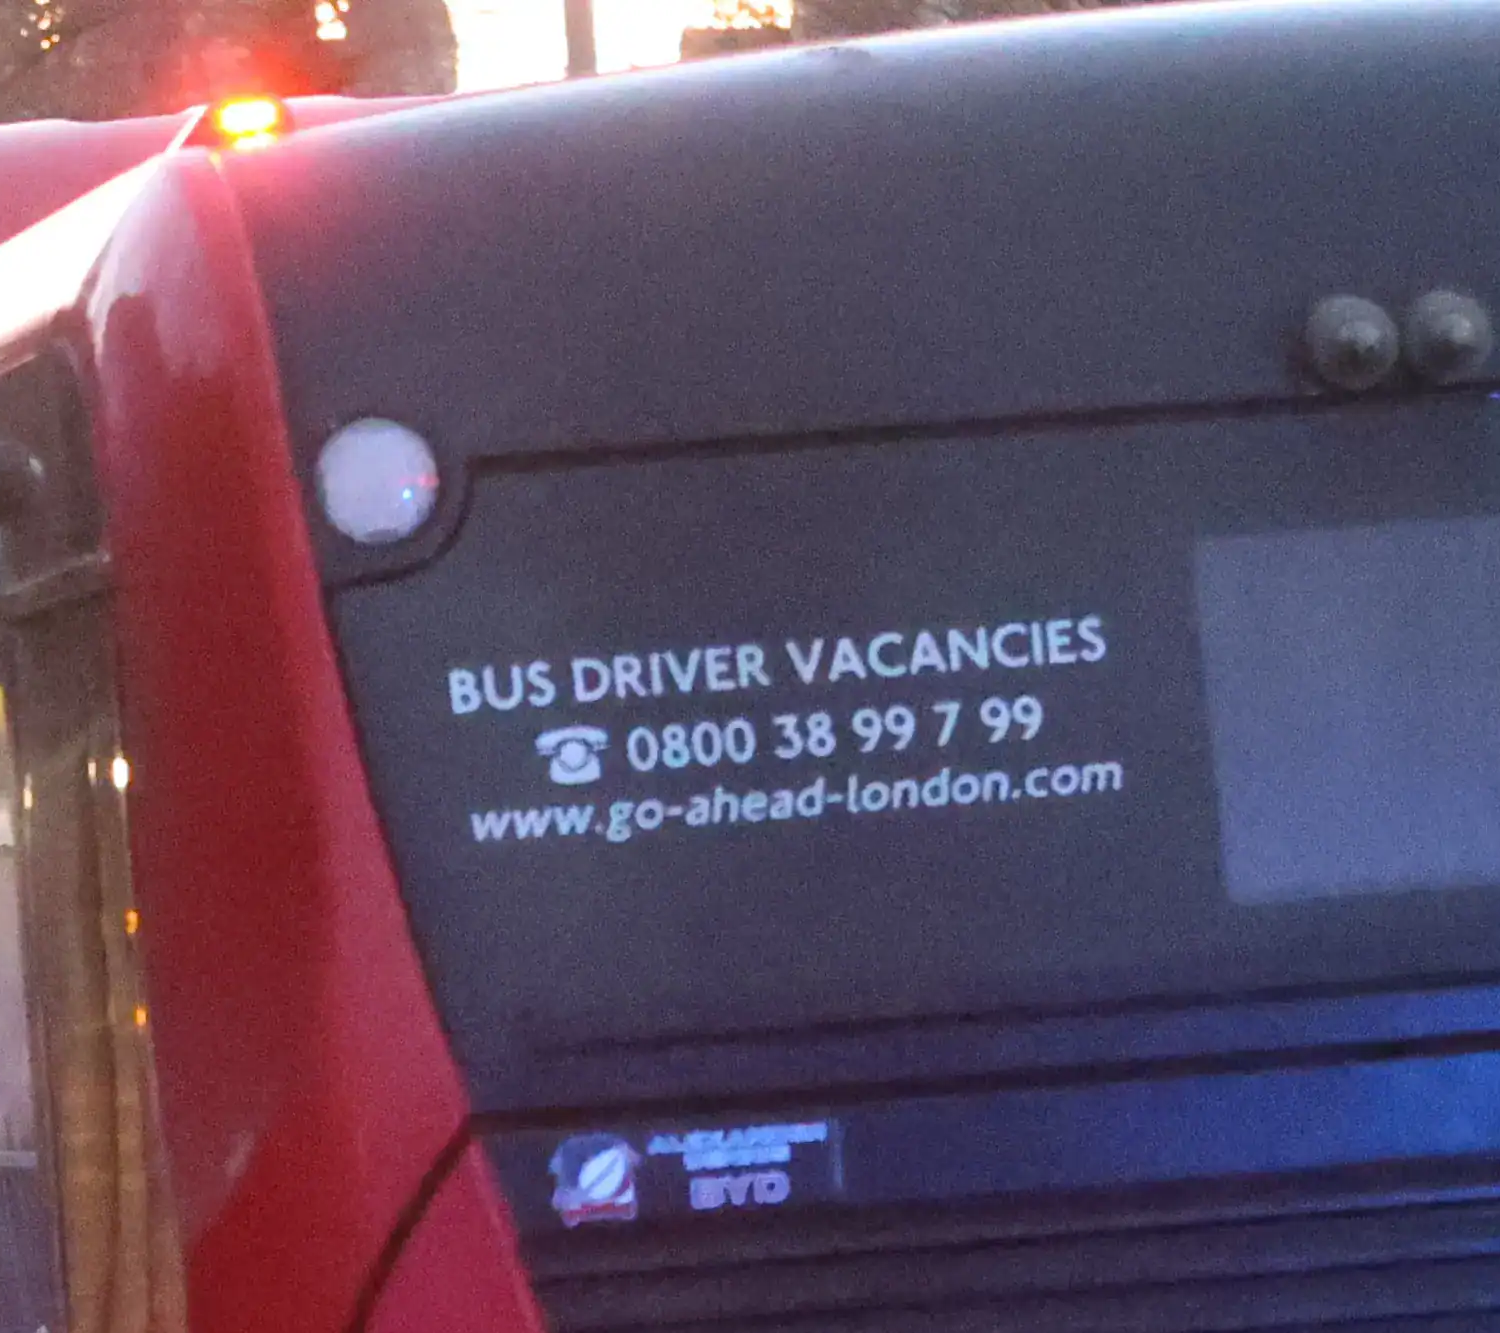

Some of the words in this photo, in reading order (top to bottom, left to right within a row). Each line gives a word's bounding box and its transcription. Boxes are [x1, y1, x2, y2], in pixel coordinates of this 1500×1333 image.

[448, 662, 556, 714] BUS
[572, 644, 771, 704] DRIVER
[786, 616, 1107, 686] VACANCIES
[627, 719, 757, 771] 0800
[774, 712, 836, 760] 38
[853, 705, 916, 752] 99
[934, 701, 958, 746] 7
[980, 694, 1045, 743] 99
[471, 757, 1124, 843] www.go-ahead-london.com
